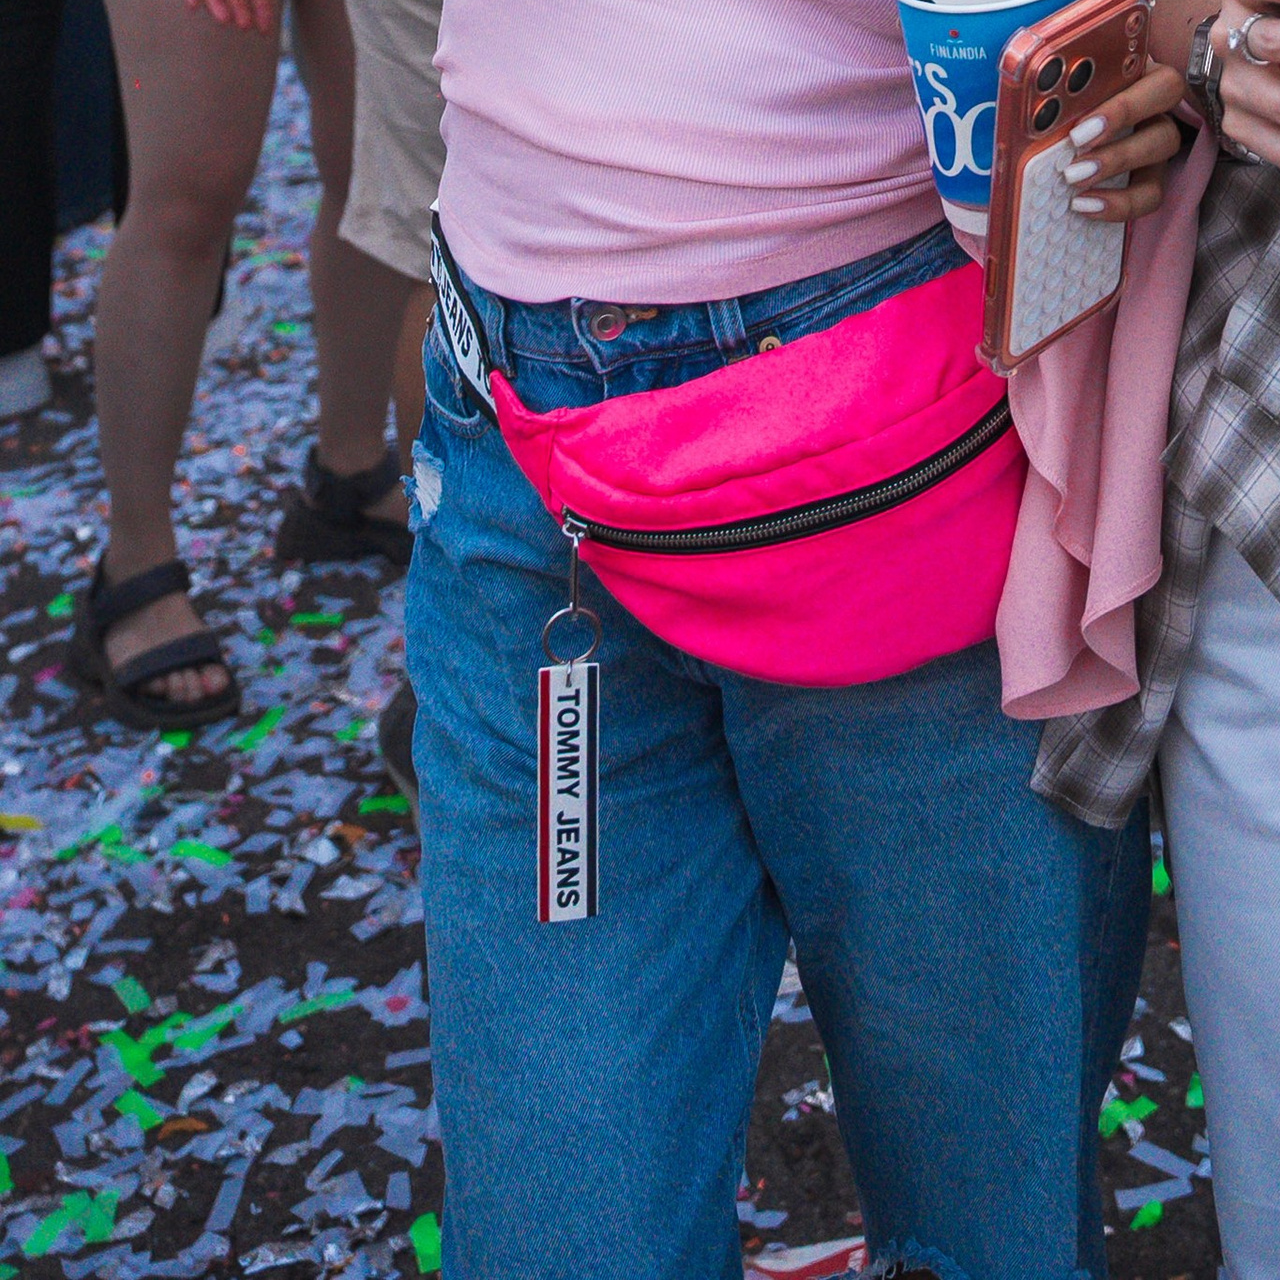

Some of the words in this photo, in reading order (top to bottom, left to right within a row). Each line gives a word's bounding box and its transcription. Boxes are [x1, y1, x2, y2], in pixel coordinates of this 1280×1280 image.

[930, 43, 987, 60] FINLANDIA
[556, 688, 581, 799] TOMMY
[556, 810, 581, 909] JEANS
